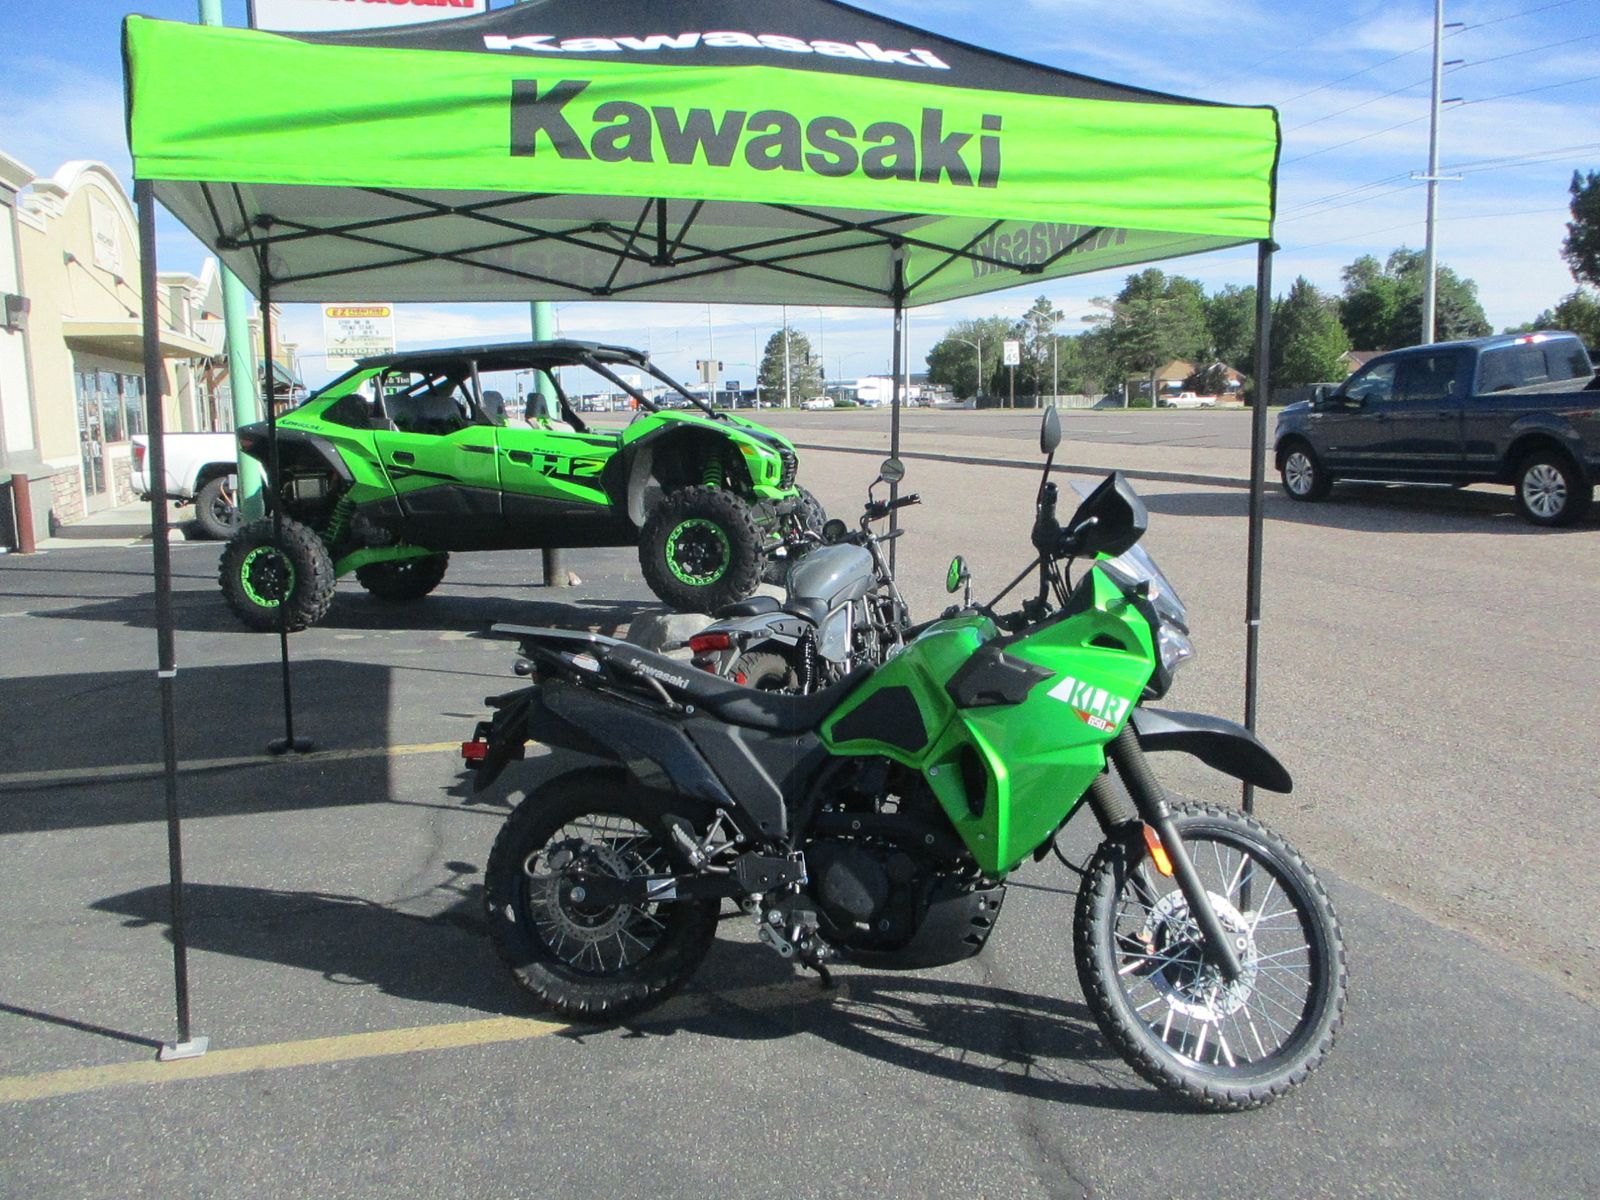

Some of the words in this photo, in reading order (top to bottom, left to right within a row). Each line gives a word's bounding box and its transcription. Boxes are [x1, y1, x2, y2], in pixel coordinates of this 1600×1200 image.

[484, 31, 951, 70] Kawasaki
[510, 79, 1003, 188] Kawasaki
[1006, 353, 1018, 362] 45
[631, 659, 690, 689] Kawasaki
[1066, 678, 1121, 724] KLR
